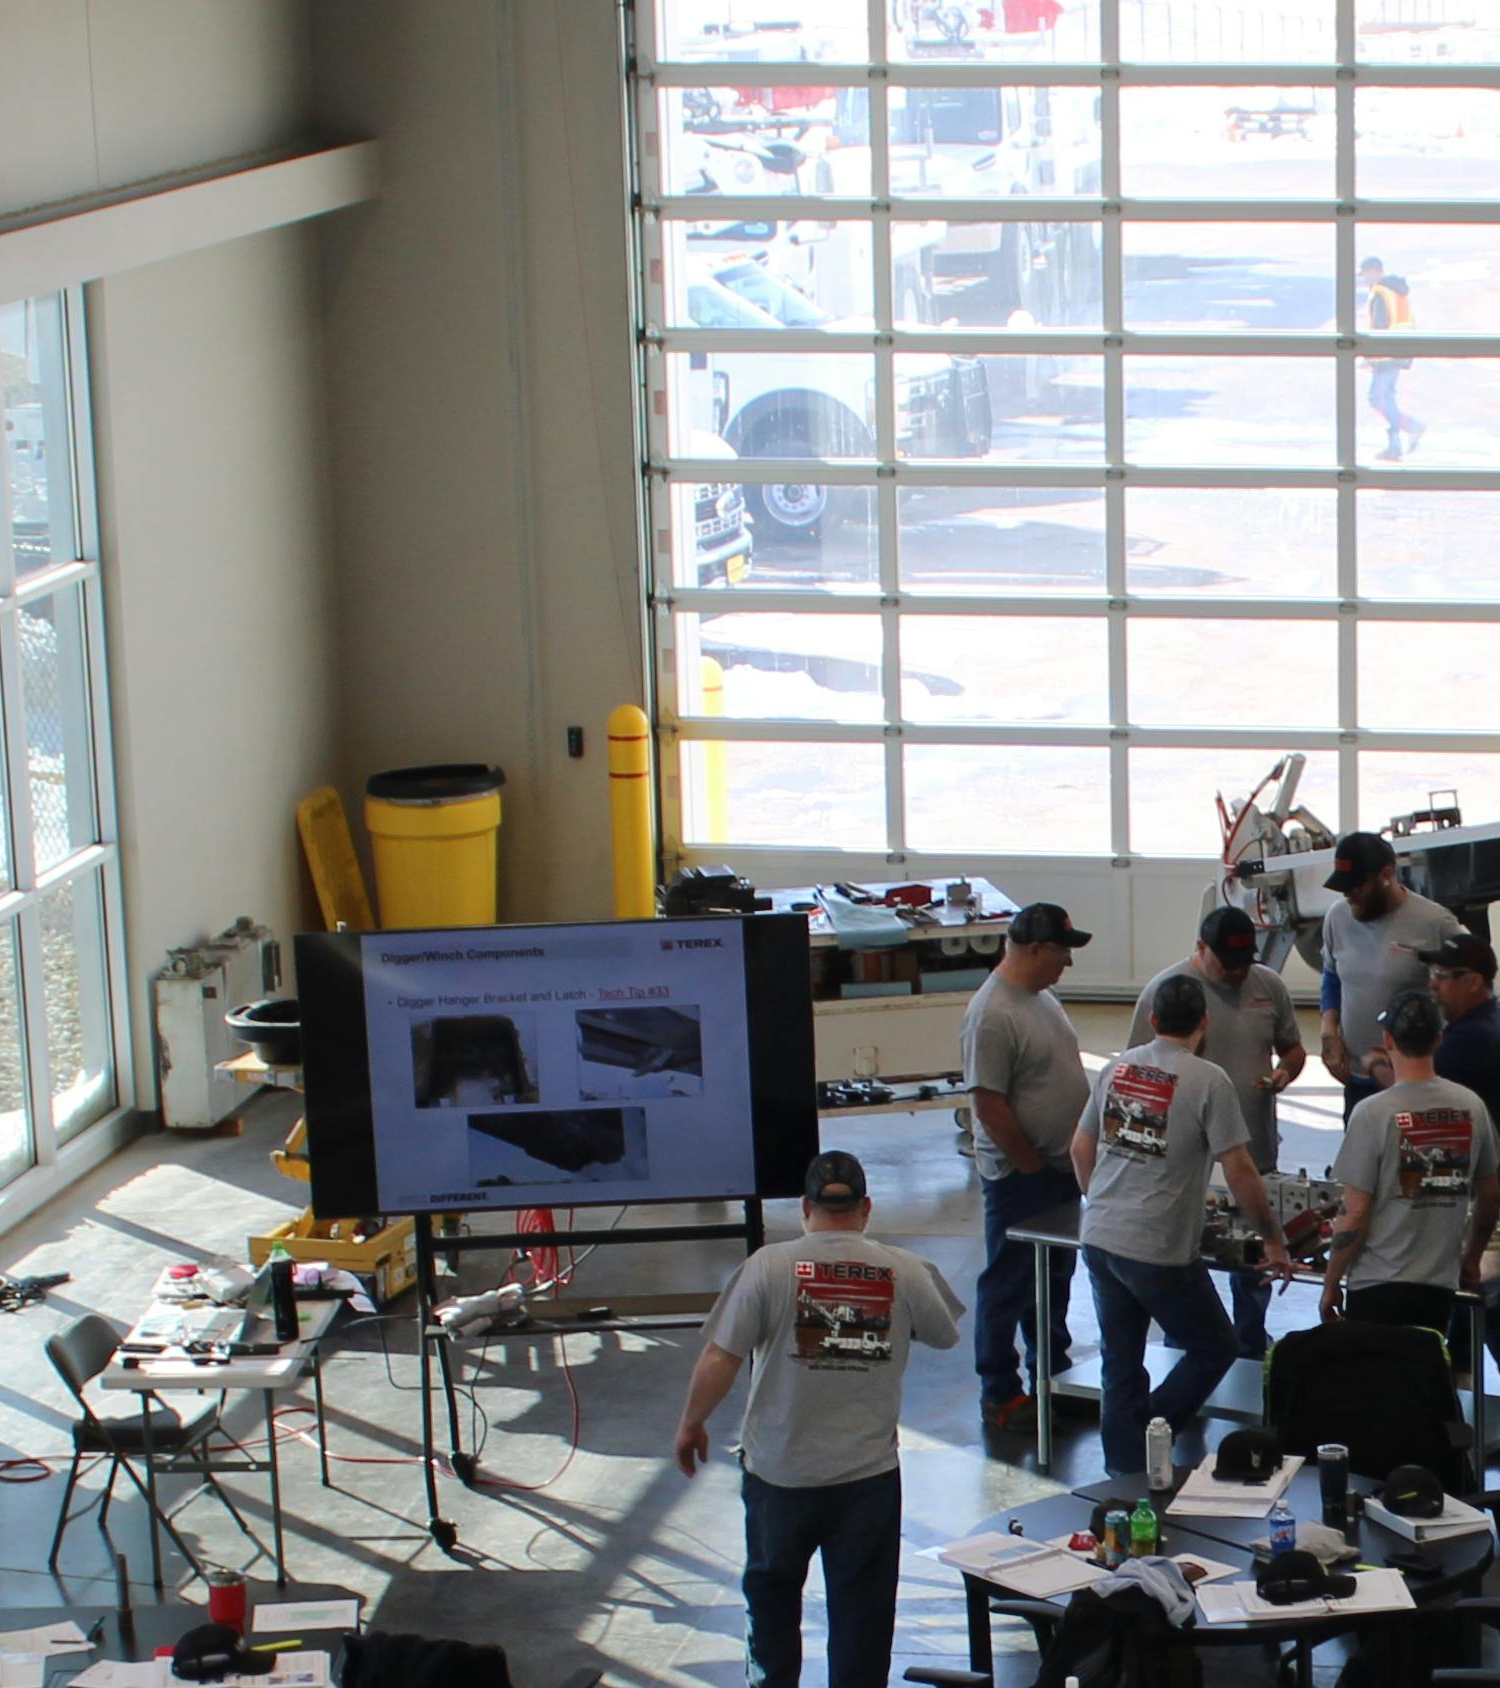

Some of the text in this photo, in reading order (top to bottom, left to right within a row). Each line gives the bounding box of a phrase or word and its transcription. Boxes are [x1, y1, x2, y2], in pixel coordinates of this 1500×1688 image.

[676, 938, 723, 949] TEREX
[381, 947, 545, 965] Digger/Winch Components
[397, 996, 434, 1009] Digger
[438, 994, 480, 1007] Hanger
[484, 992, 527, 1003] Bracket
[531, 991, 551, 1001] and
[555, 990, 586, 1000] Latch
[598, 988, 623, 999] Tech
[628, 986, 645, 999] Tip
[1129, 1065, 1178, 1084] TEREX
[819, 1263, 893, 1281] TEREX
